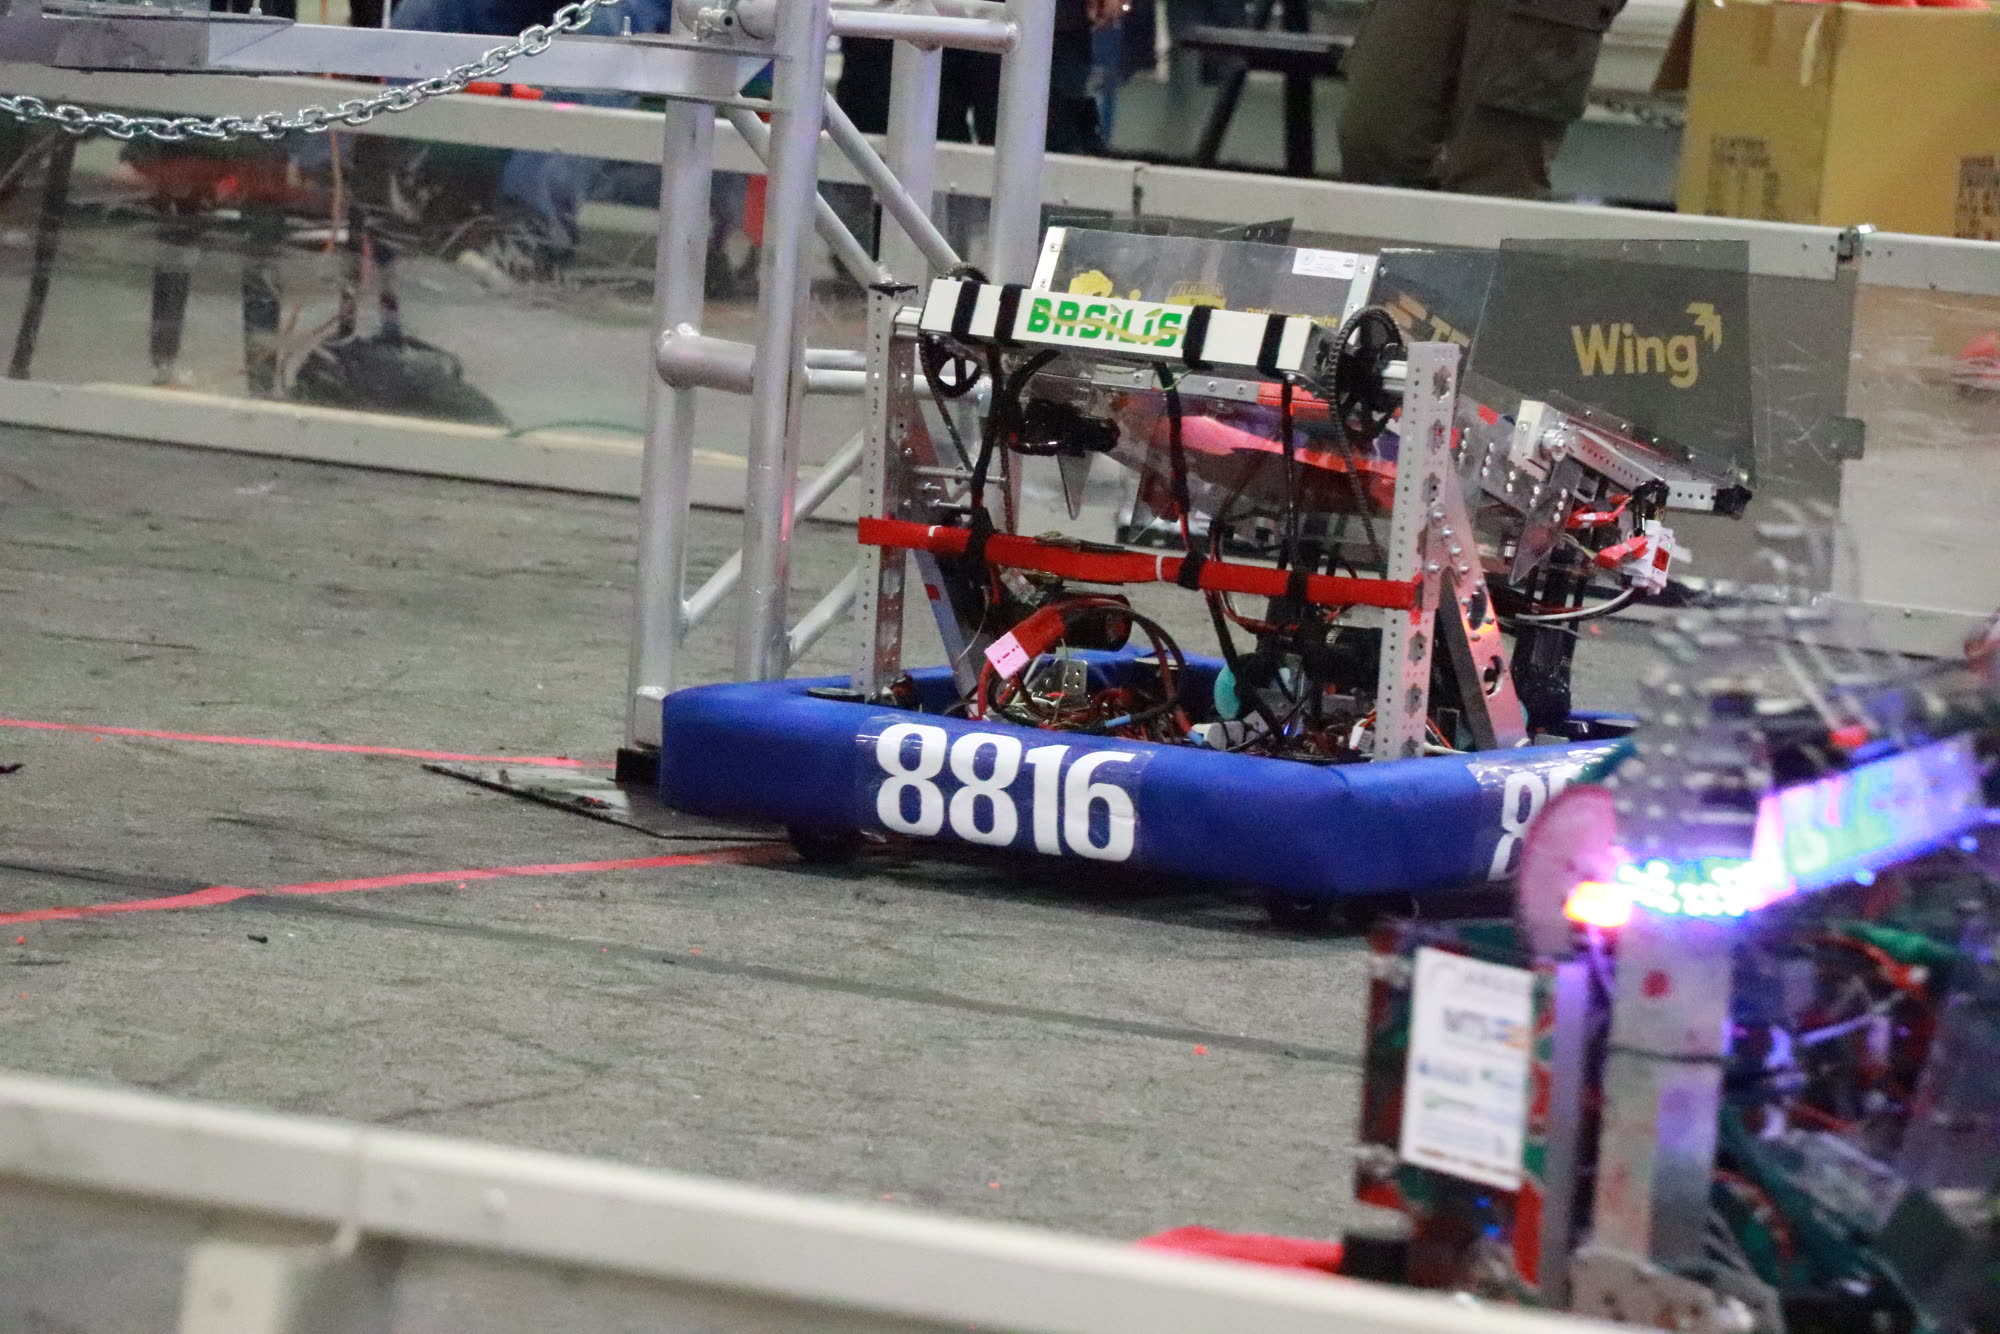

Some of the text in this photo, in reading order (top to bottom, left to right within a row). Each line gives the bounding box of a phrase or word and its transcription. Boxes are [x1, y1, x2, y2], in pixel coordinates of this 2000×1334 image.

[1026, 297, 1192, 349] BASILIS
[1571, 323, 1698, 389] Wing
[876, 723, 1136, 862] 8816
[1487, 766, 1581, 881] 8
